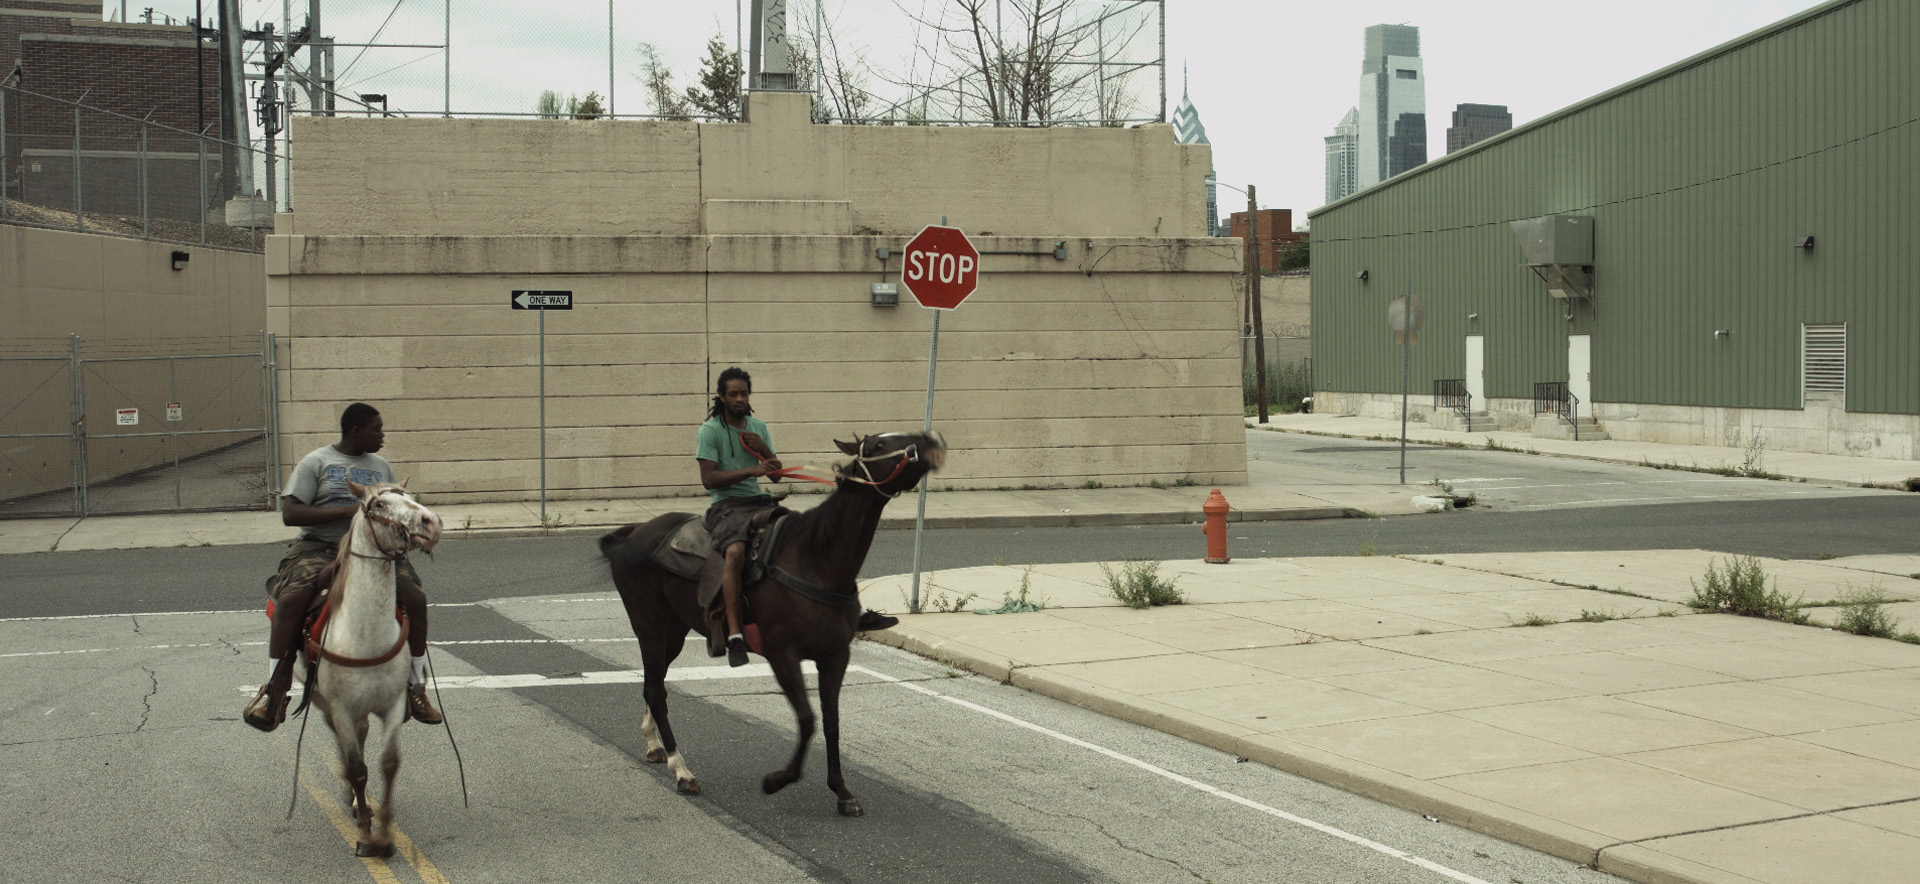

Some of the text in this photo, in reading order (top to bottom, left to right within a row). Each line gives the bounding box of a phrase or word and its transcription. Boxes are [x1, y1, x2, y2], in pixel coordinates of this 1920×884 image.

[908, 250, 974, 284] STOP
[530, 296, 566, 305] ONE WAY
